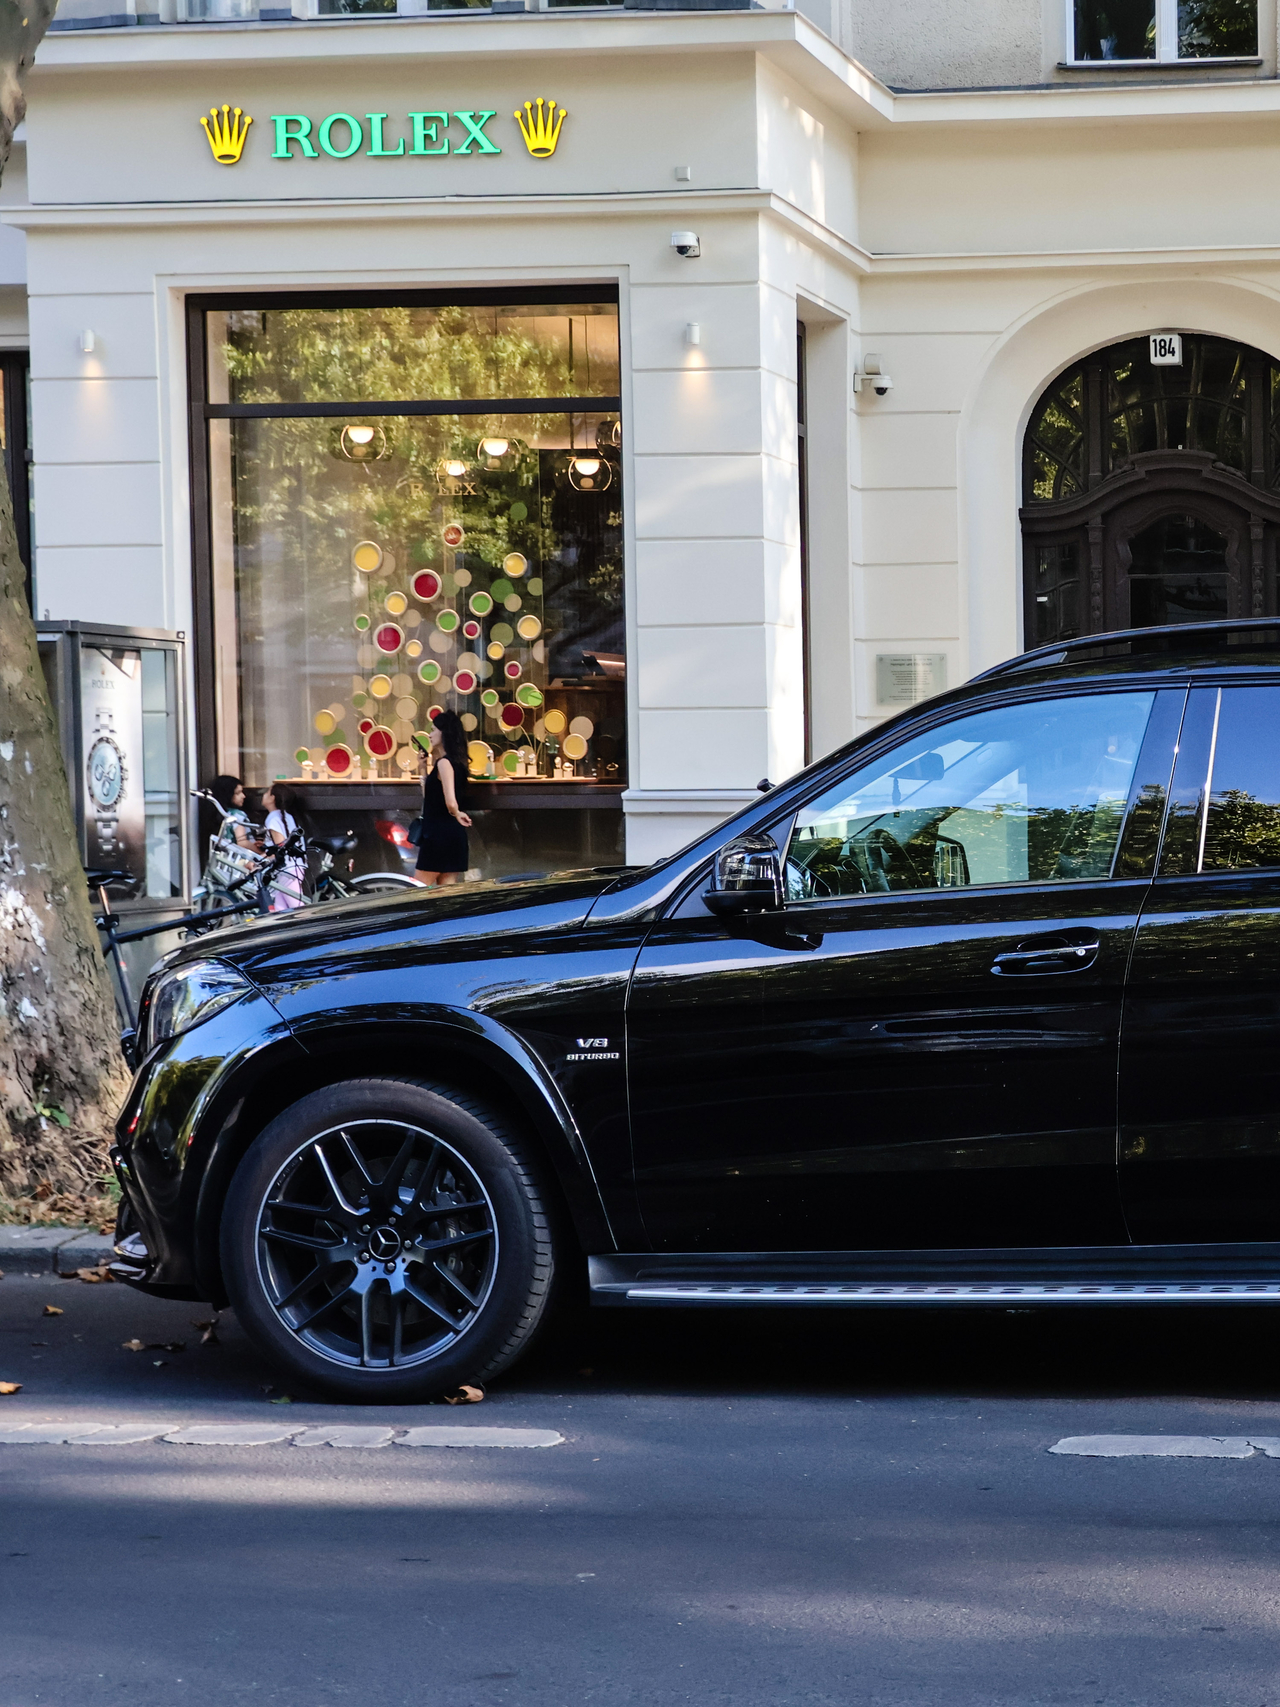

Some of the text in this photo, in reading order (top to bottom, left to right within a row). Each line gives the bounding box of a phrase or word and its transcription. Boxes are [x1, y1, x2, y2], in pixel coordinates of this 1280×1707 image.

[270, 110, 502, 159] ROLEX
[1152, 337, 1176, 358] 184
[409, 482, 477, 496] RLEX
[91, 678, 116, 690] ROLEX
[576, 1038, 609, 1048] V8
[566, 1052, 620, 1061] BITURBO
